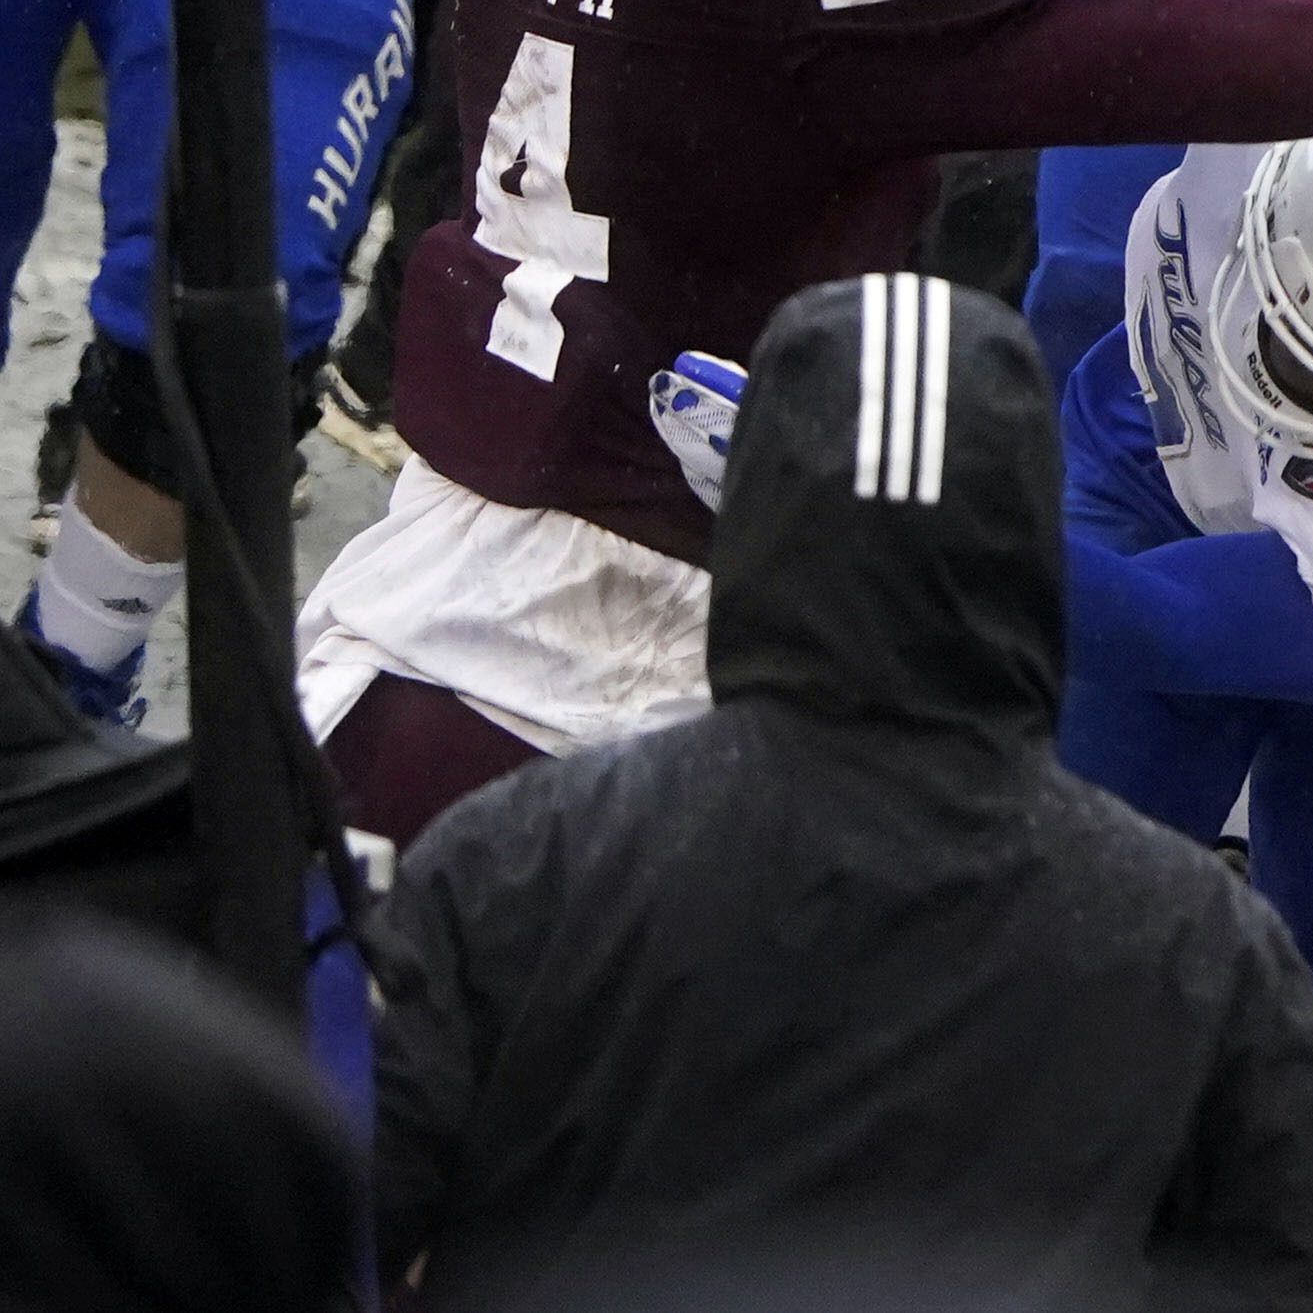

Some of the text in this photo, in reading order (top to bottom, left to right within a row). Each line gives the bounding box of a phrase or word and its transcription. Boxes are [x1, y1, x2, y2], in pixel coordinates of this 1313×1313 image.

[472, 32, 610, 383] 4
[1153, 198, 1230, 453] Tulsa
[1246, 350, 1283, 410] Riddell
